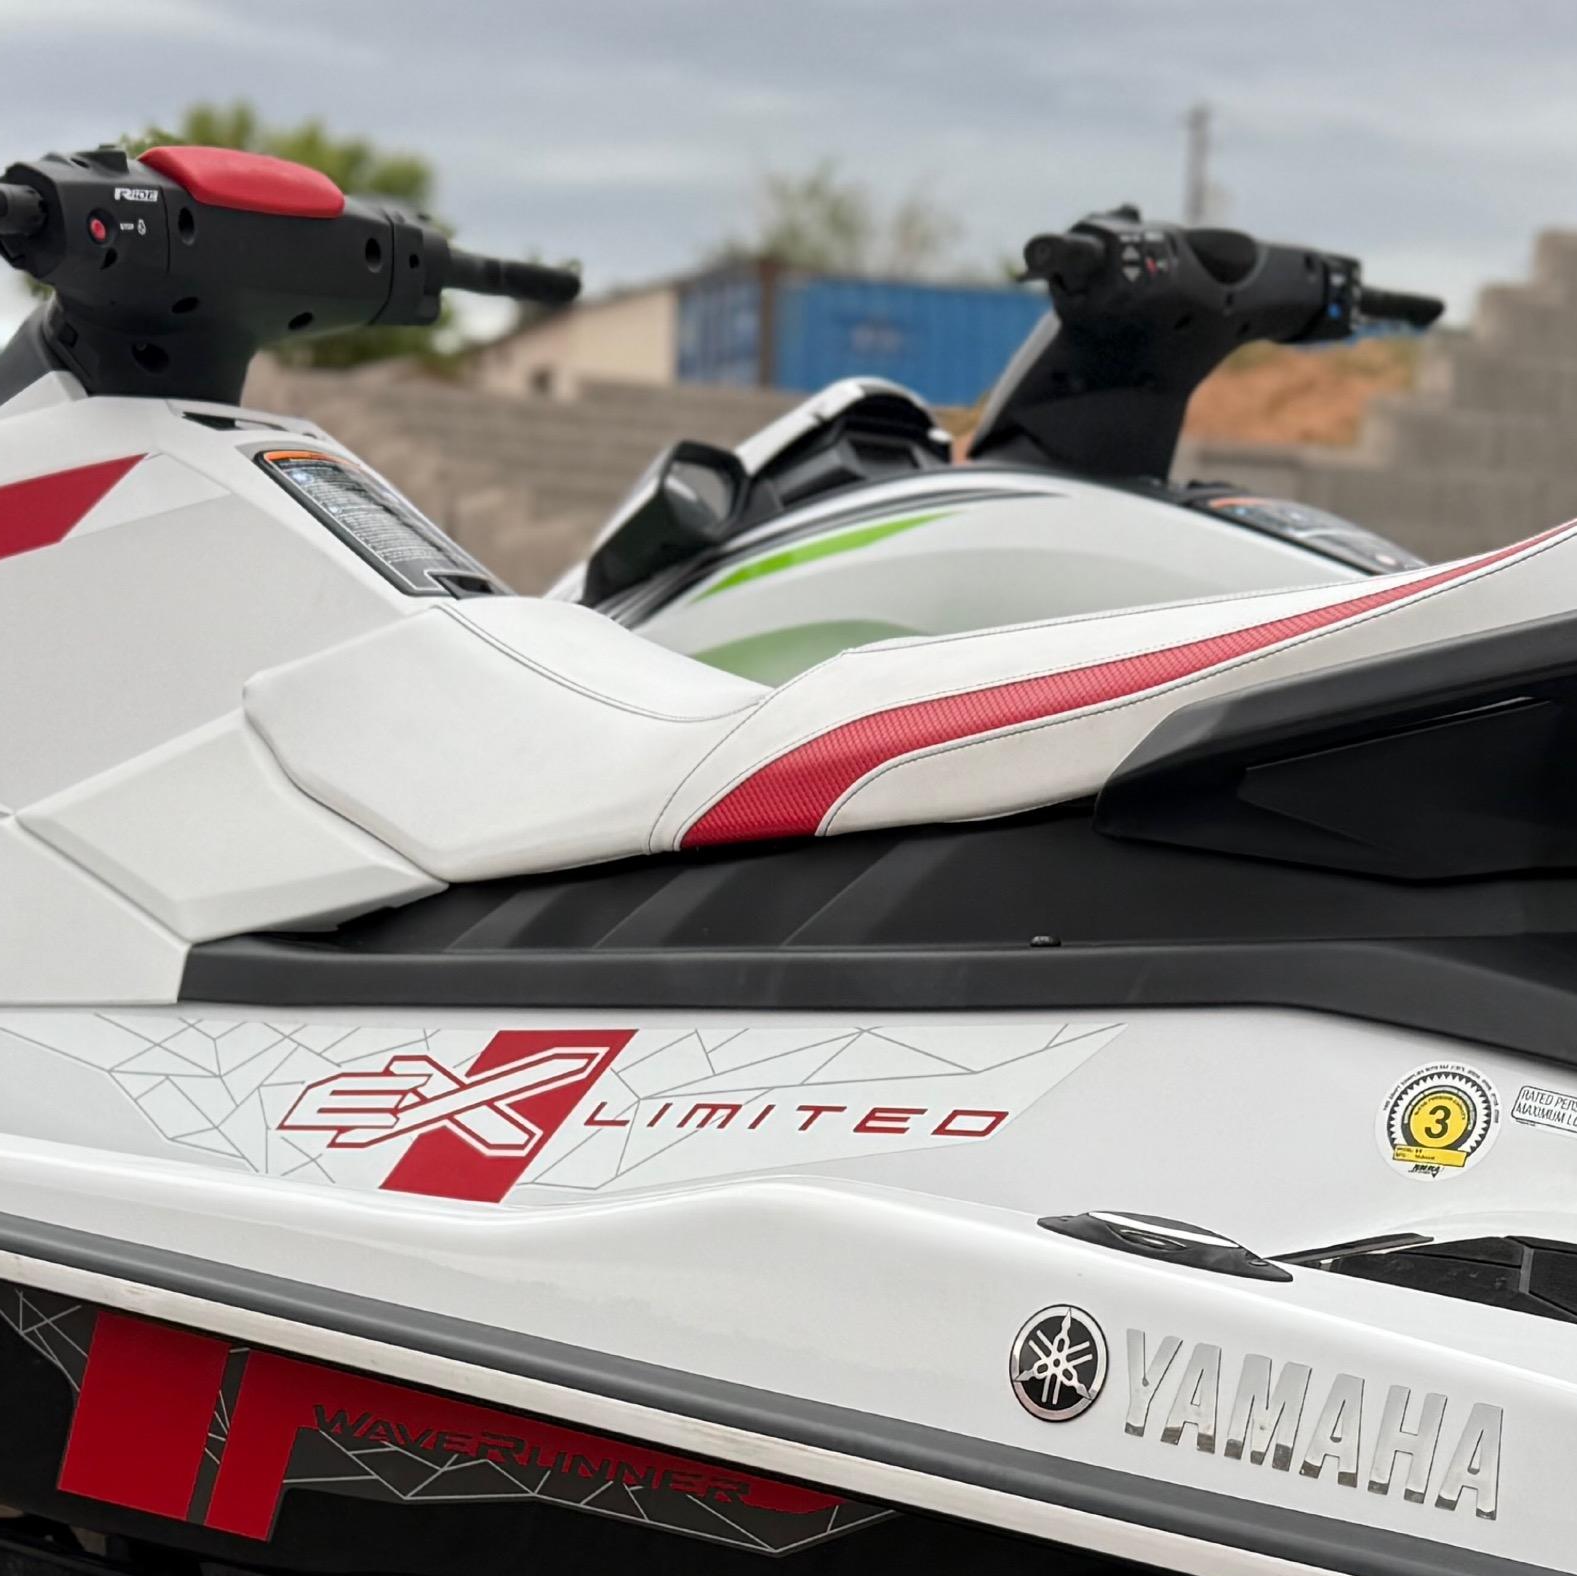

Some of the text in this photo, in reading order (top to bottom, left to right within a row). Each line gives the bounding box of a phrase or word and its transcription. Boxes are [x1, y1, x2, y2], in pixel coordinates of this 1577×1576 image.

[1516, 1102, 1566, 1123] MAXIMUM
[1521, 1089, 1554, 1106] RATED
[583, 1101, 1010, 1137] LIMITED
[1424, 1105, 1451, 1139] 3
[1123, 1327, 1505, 1521] YAMAHA
